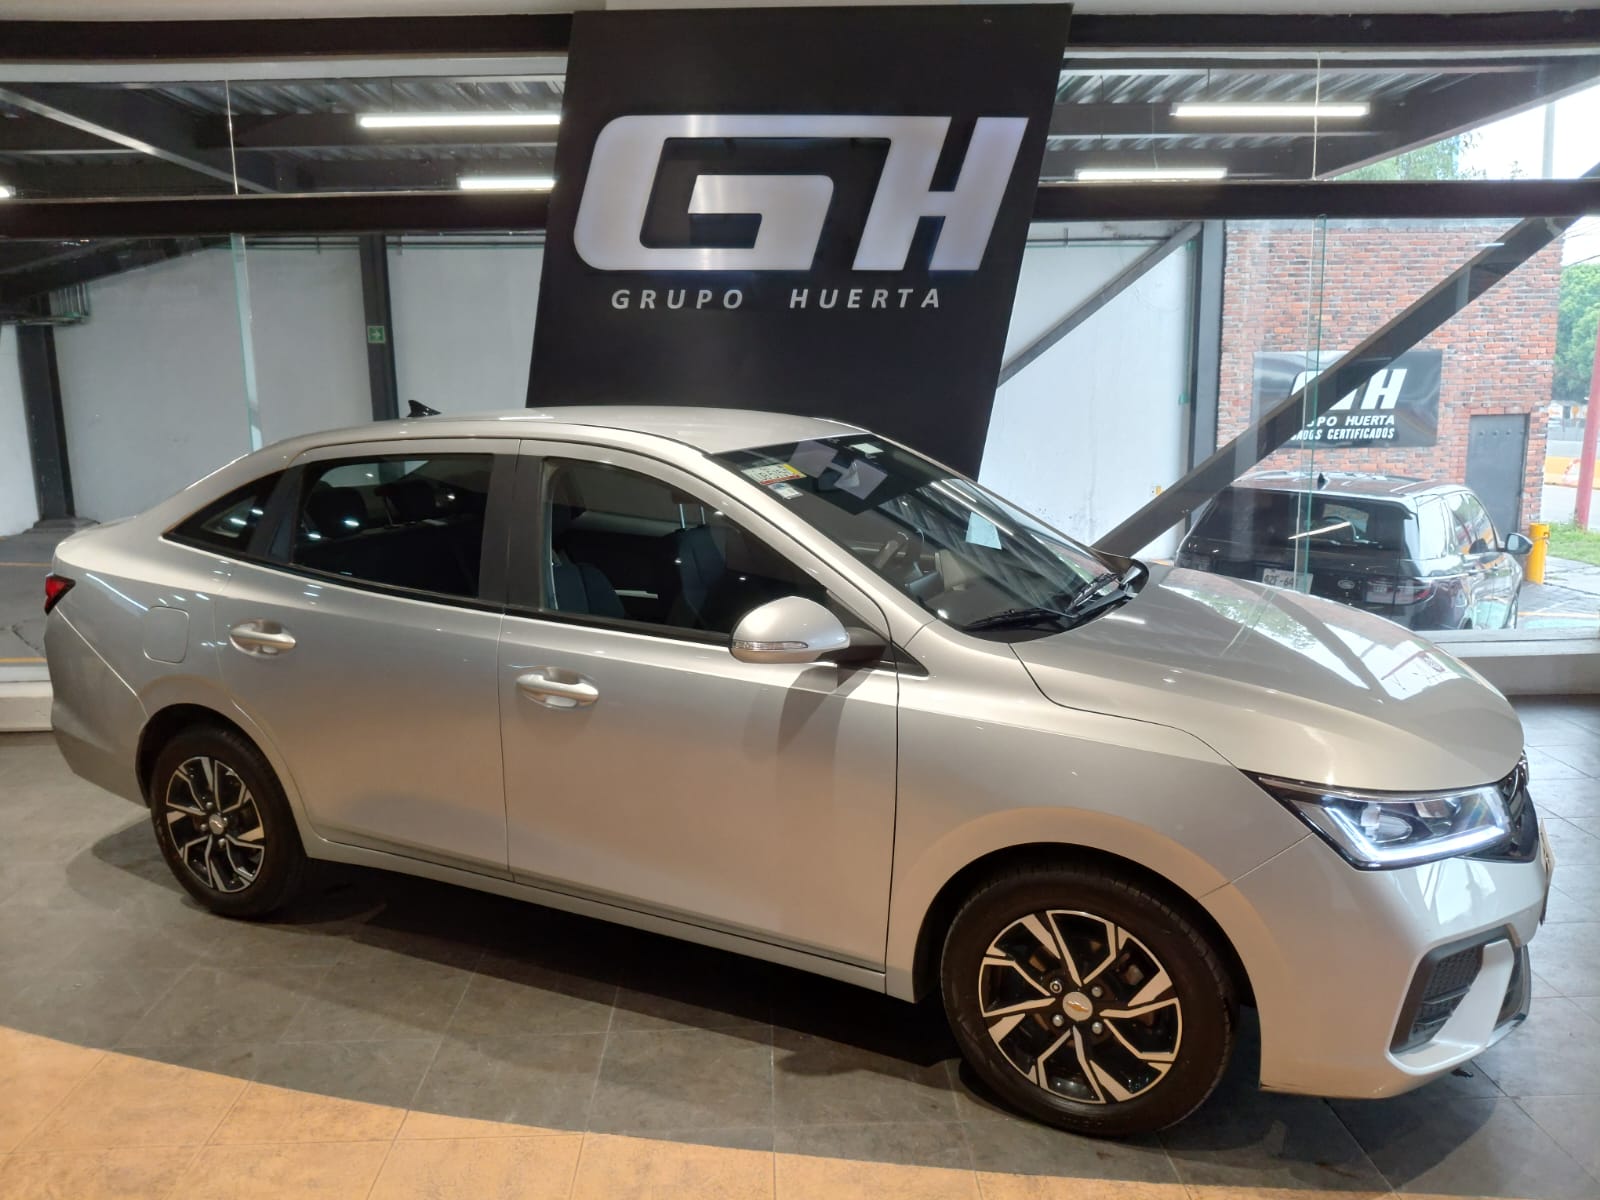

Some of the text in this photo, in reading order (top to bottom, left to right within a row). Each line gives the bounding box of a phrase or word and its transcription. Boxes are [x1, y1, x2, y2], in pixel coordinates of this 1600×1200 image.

[574, 114, 1029, 271] GH
[611, 288, 940, 310] GRUPO HUERTA
[1345, 415, 1395, 427] HUERTA
[1290, 427, 1395, 441] ADOS CERTIFICADOS
